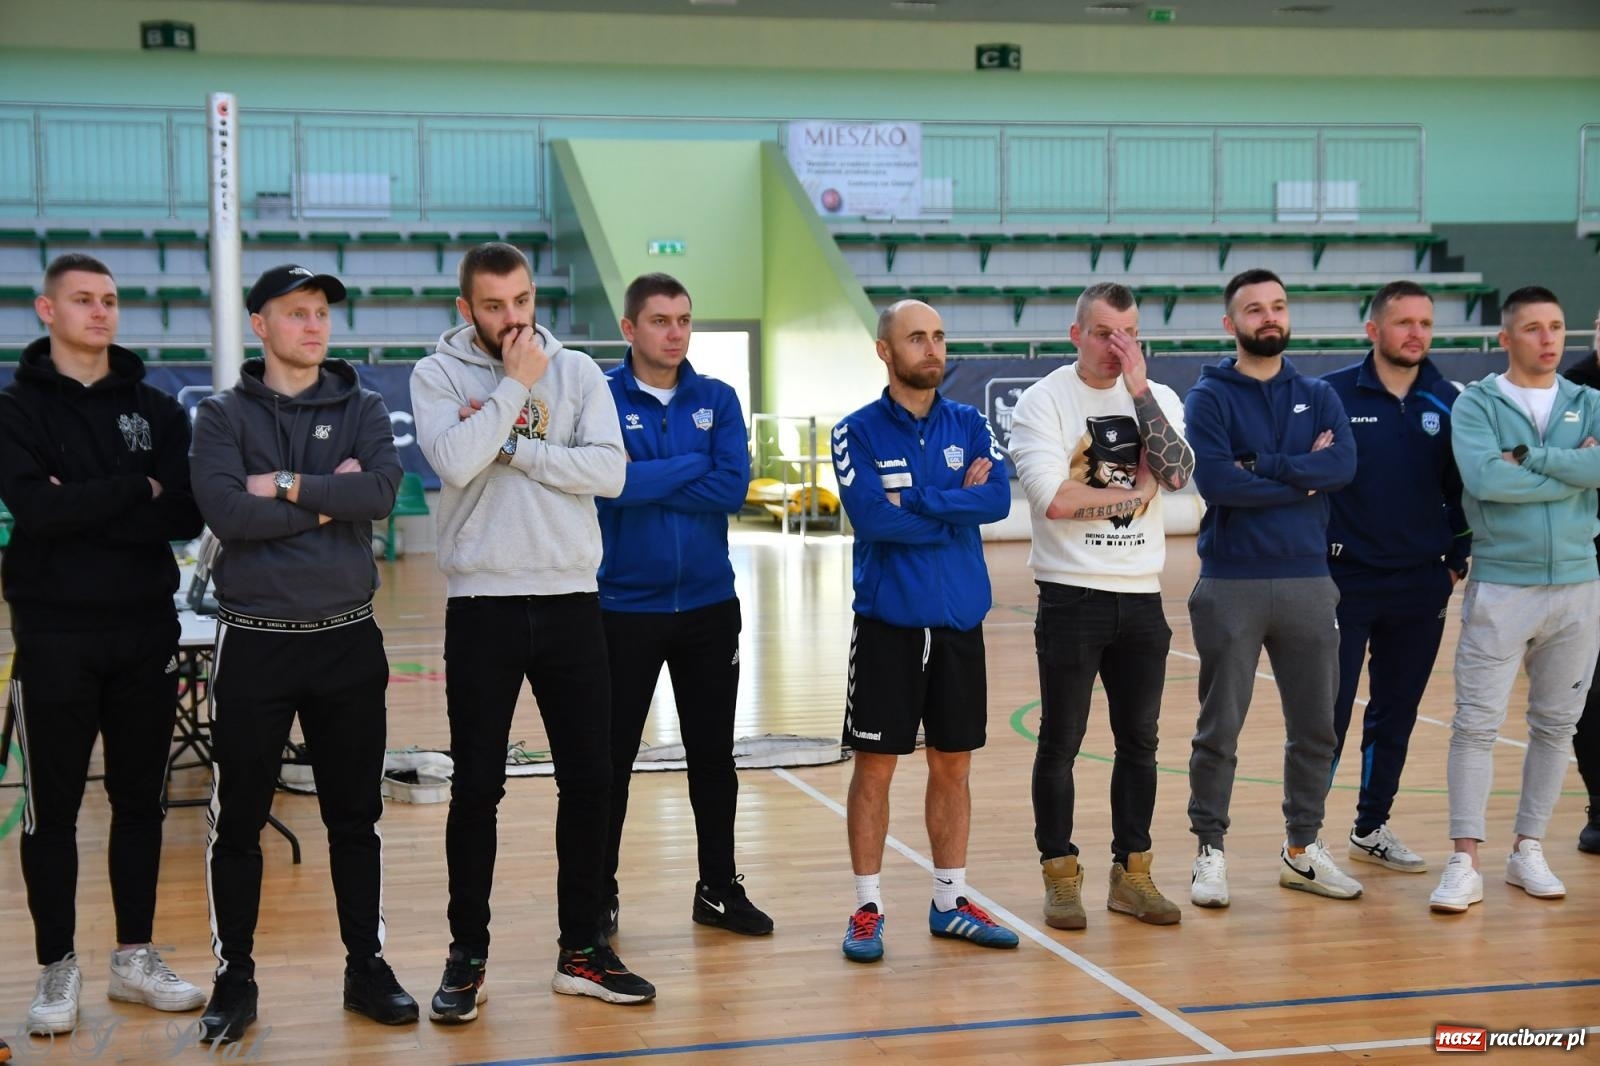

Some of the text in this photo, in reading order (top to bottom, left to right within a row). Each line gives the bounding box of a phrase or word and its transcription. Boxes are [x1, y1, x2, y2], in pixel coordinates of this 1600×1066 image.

[147, 30, 161, 46] B
[174, 30, 190, 47] B
[980, 51, 1000, 67] C
[804, 126, 907, 146] MIESZKO
[1331, 543, 1343, 556] 17
[852, 727, 882, 741] hummel
